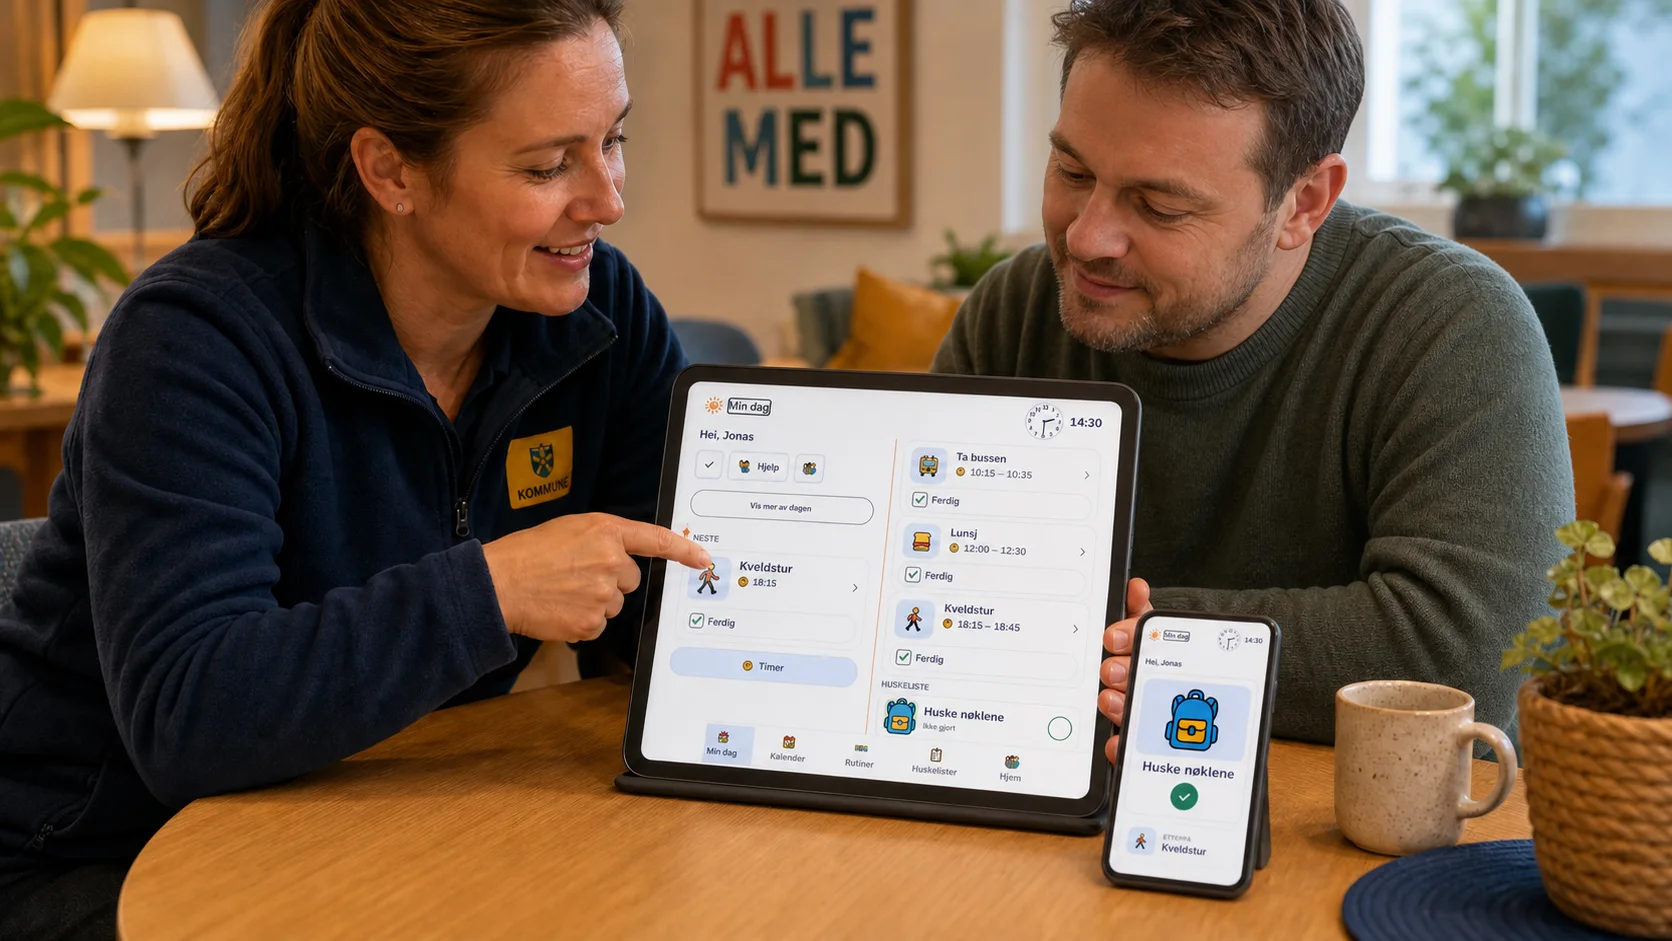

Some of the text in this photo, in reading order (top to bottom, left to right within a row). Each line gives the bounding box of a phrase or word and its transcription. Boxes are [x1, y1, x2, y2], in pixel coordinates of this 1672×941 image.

[716, 9, 877, 91] ALLE
[724, 107, 879, 189] MED
[728, 401, 769, 414] Min dag
[1069, 416, 1103, 429] 14:30
[699, 429, 755, 441] Hei, Jonas
[956, 451, 1007, 464] Ta bussen
[757, 462, 780, 474] Hjelp
[970, 467, 996, 478] 10:15
[1006, 469, 1033, 480] 10:35
[516, 475, 569, 501] KOMMUNE
[750, 501, 762, 510] Vis
[789, 503, 812, 513] dagen
[931, 495, 960, 508] Ferdig
[692, 534, 720, 543] NESTE
[950, 527, 978, 541] Lunsj
[963, 544, 990, 554] 12:00
[1000, 546, 1027, 557] 12:30
[739, 560, 793, 574] Kveldstur
[752, 577, 778, 588] 18:15
[924, 570, 954, 583] Ferdig
[944, 603, 995, 616] Kveldstur
[707, 616, 736, 630] Ferdig
[957, 619, 983, 630] 18:15
[994, 621, 1021, 632] 18:45
[1244, 636, 1264, 645] 14:30
[915, 653, 945, 666] Ferdig
[1160, 659, 1183, 668] Jonas
[758, 661, 785, 673] Timer
[880, 680, 930, 692] HUSKELISTE
[923, 706, 1005, 723] Huske nøklene
[922, 722, 956, 733] Ikke gjort
[706, 747, 738, 759] Min dag
[769, 752, 806, 763] Kalender
[844, 758, 875, 769] Rutiner
[1142, 760, 1235, 780] Huske nøklene
[911, 764, 958, 777] Huskelister
[999, 772, 1022, 783] Hjem
[1161, 843, 1207, 856] Kveldstur
